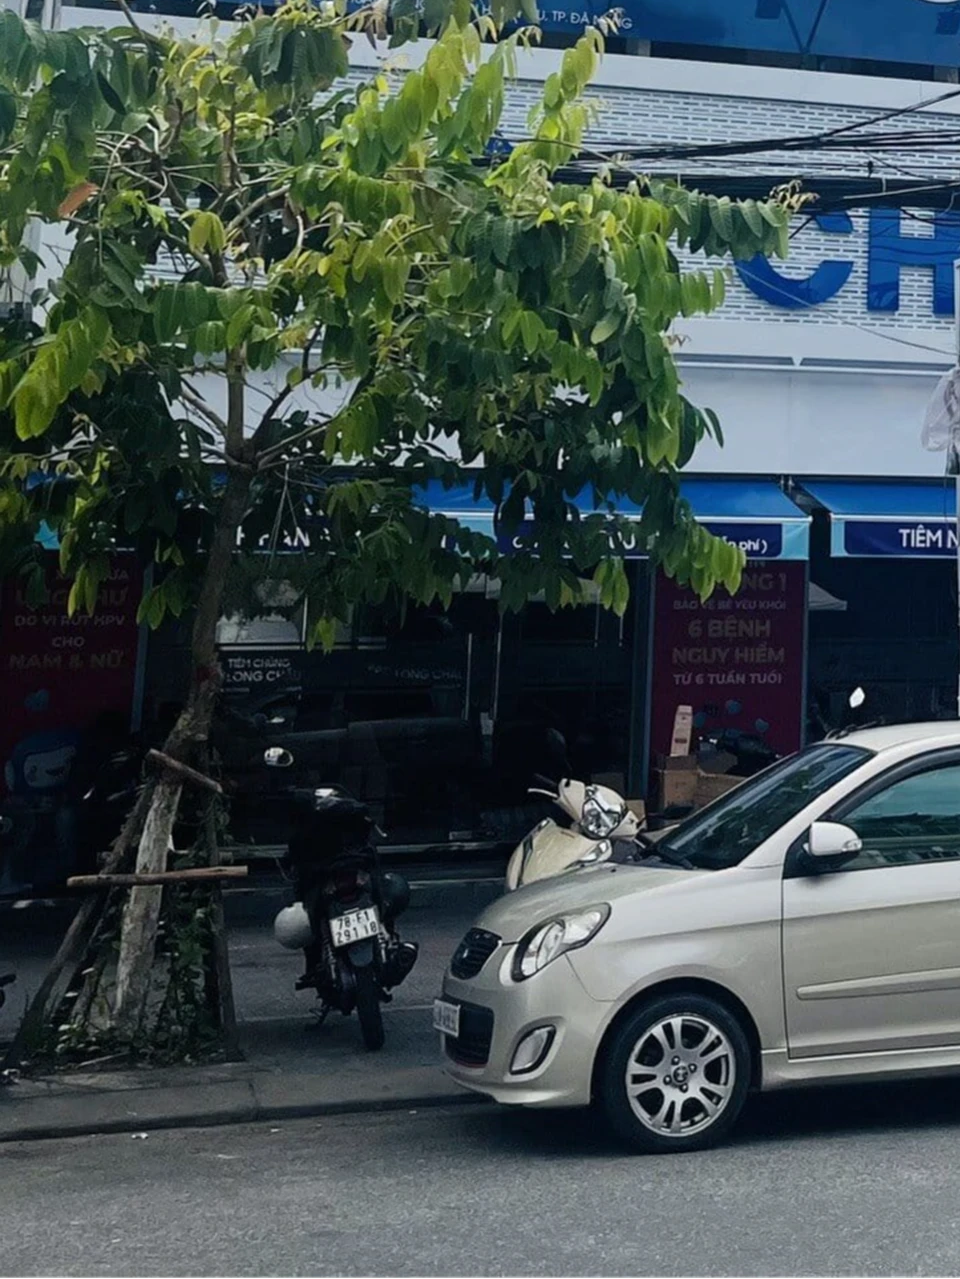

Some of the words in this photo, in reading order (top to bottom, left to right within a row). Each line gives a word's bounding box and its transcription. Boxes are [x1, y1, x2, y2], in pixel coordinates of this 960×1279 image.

[899, 524, 942, 548] TIÊM
[688, 620, 702, 637] 6
[708, 614, 771, 643] BỆNH
[52, 636, 86, 648] CHO
[672, 648, 730, 664] NGUY
[734, 641, 785, 664] HIỂM
[10, 654, 62, 669] NAM
